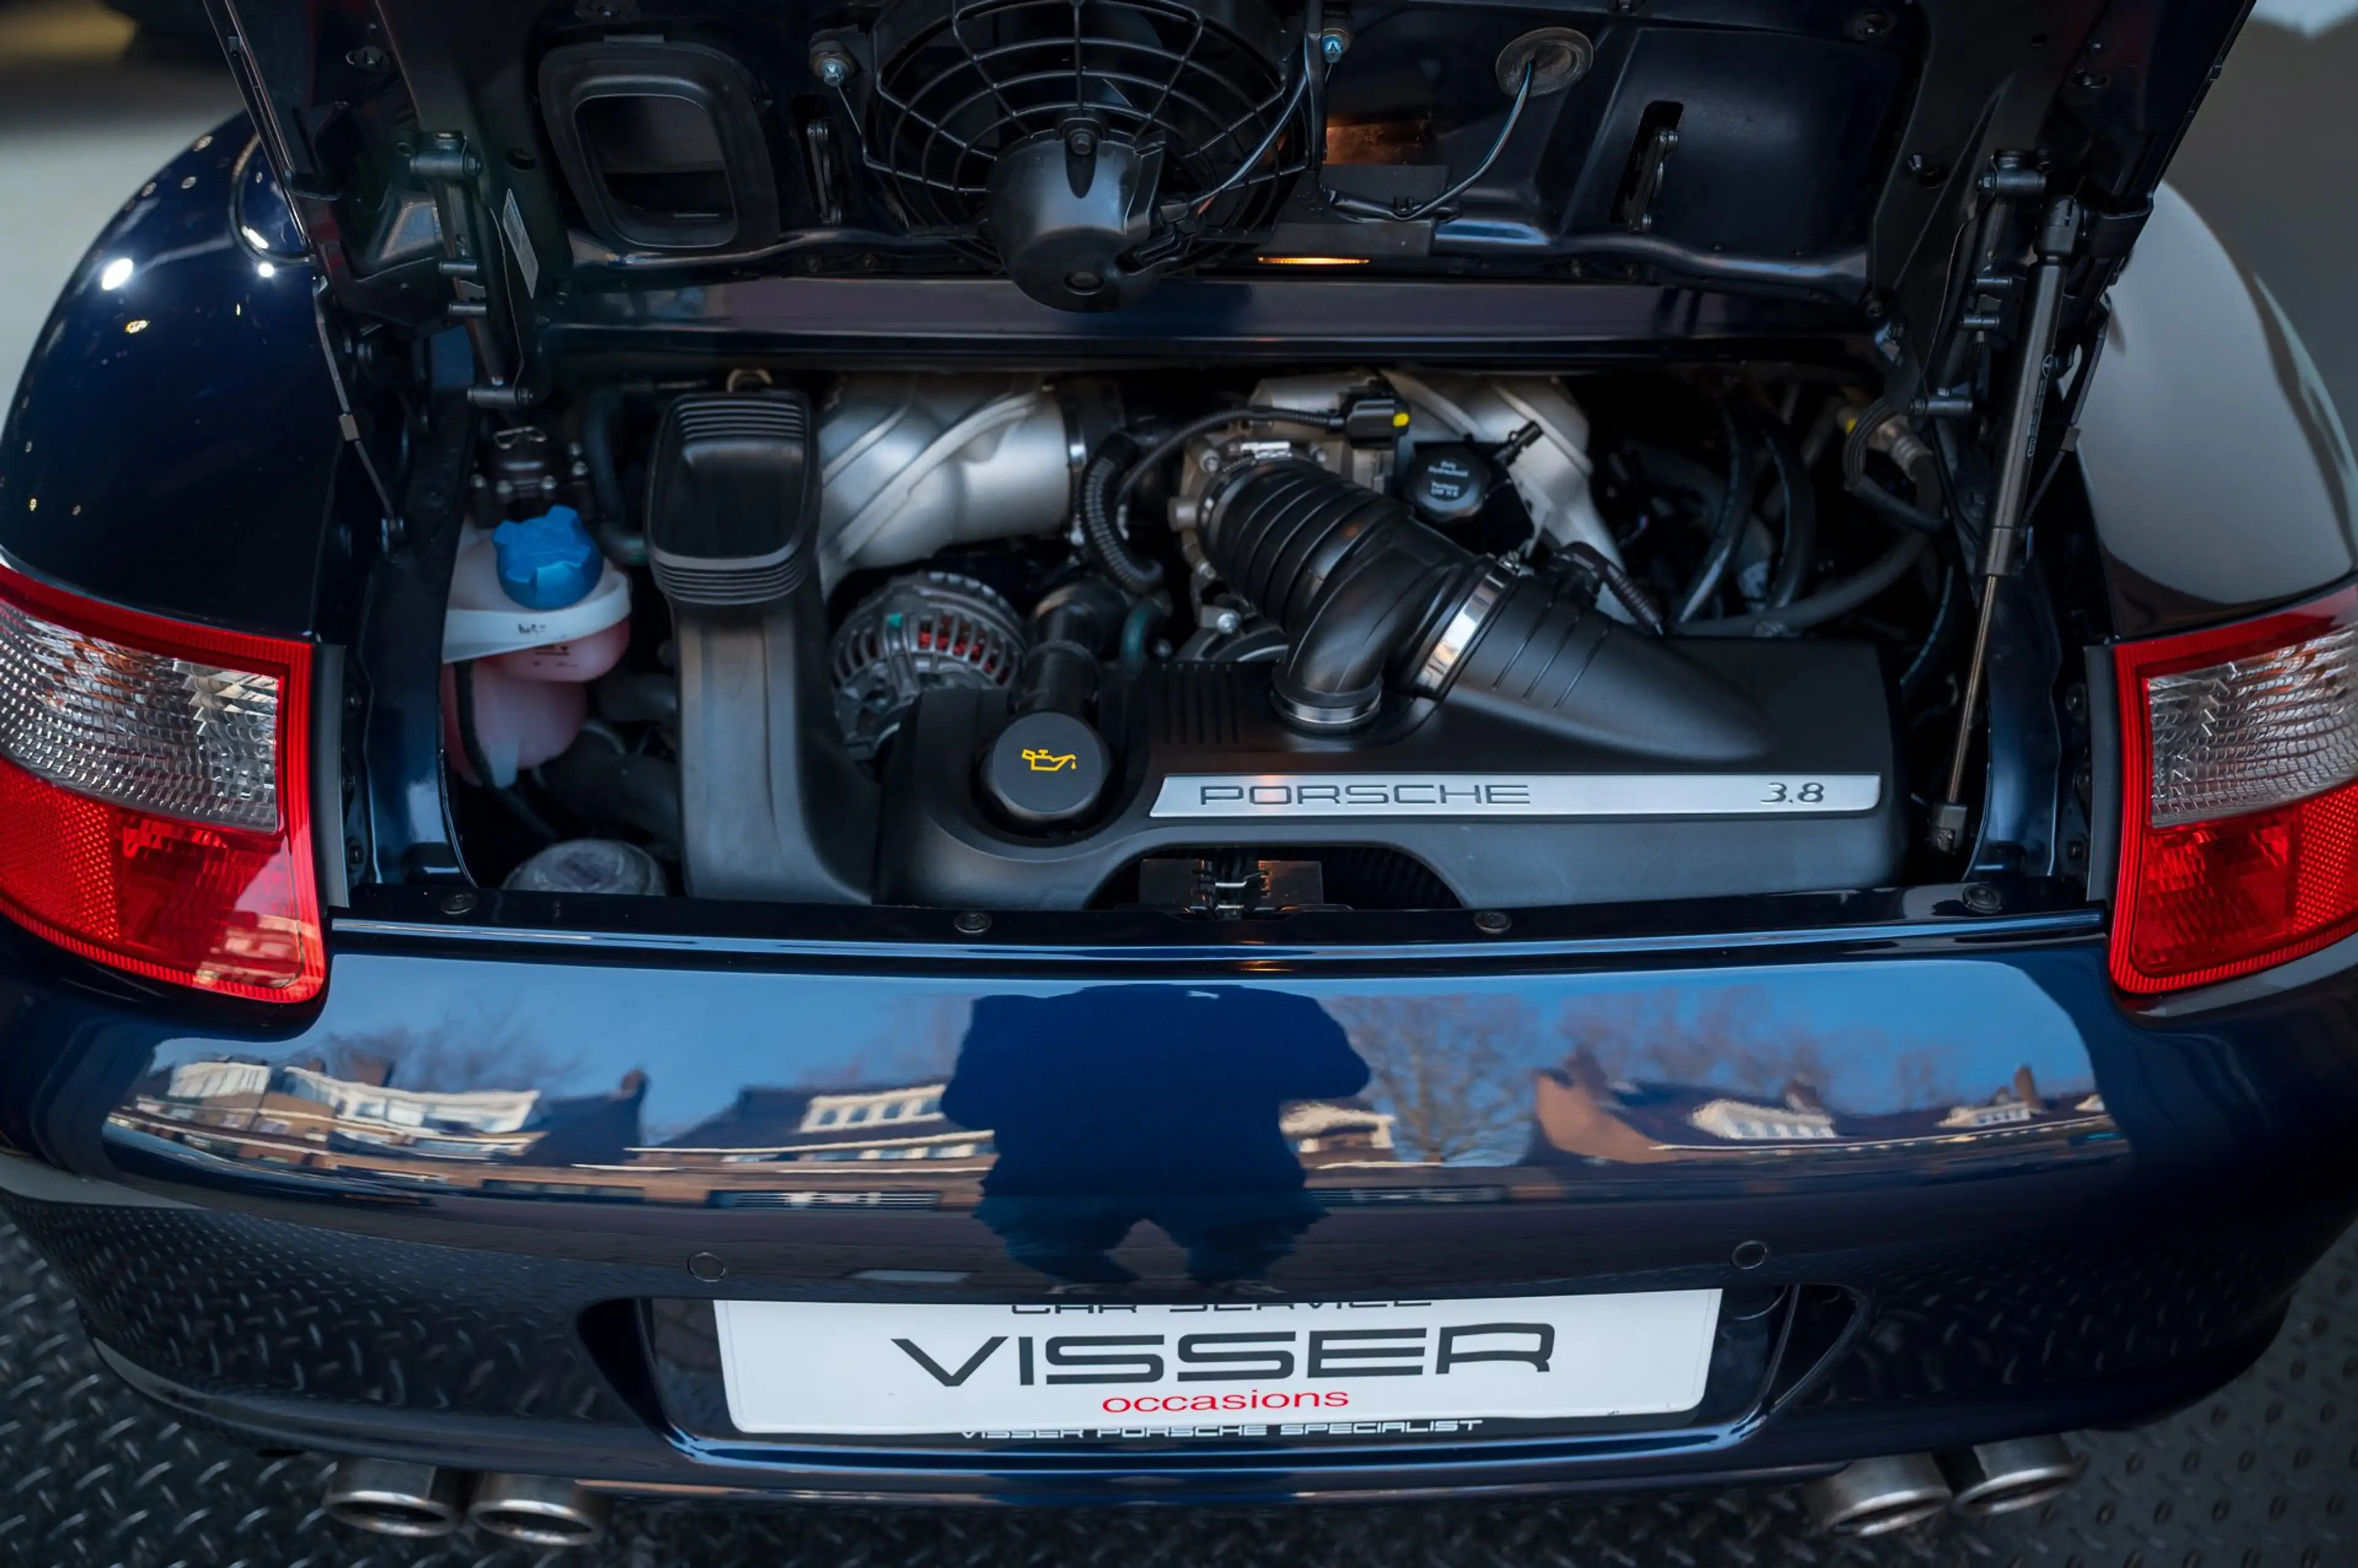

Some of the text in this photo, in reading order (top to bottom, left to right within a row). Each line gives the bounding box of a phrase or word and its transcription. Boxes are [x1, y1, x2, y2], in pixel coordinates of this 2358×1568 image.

[1200, 782, 1824, 805] PORSCHE 3.8
[890, 1322, 1555, 1387] VISSER
[1102, 1389, 1349, 1413] occasions
[961, 1419, 1483, 1439] VISSER PORSCHE SPECIALIST
